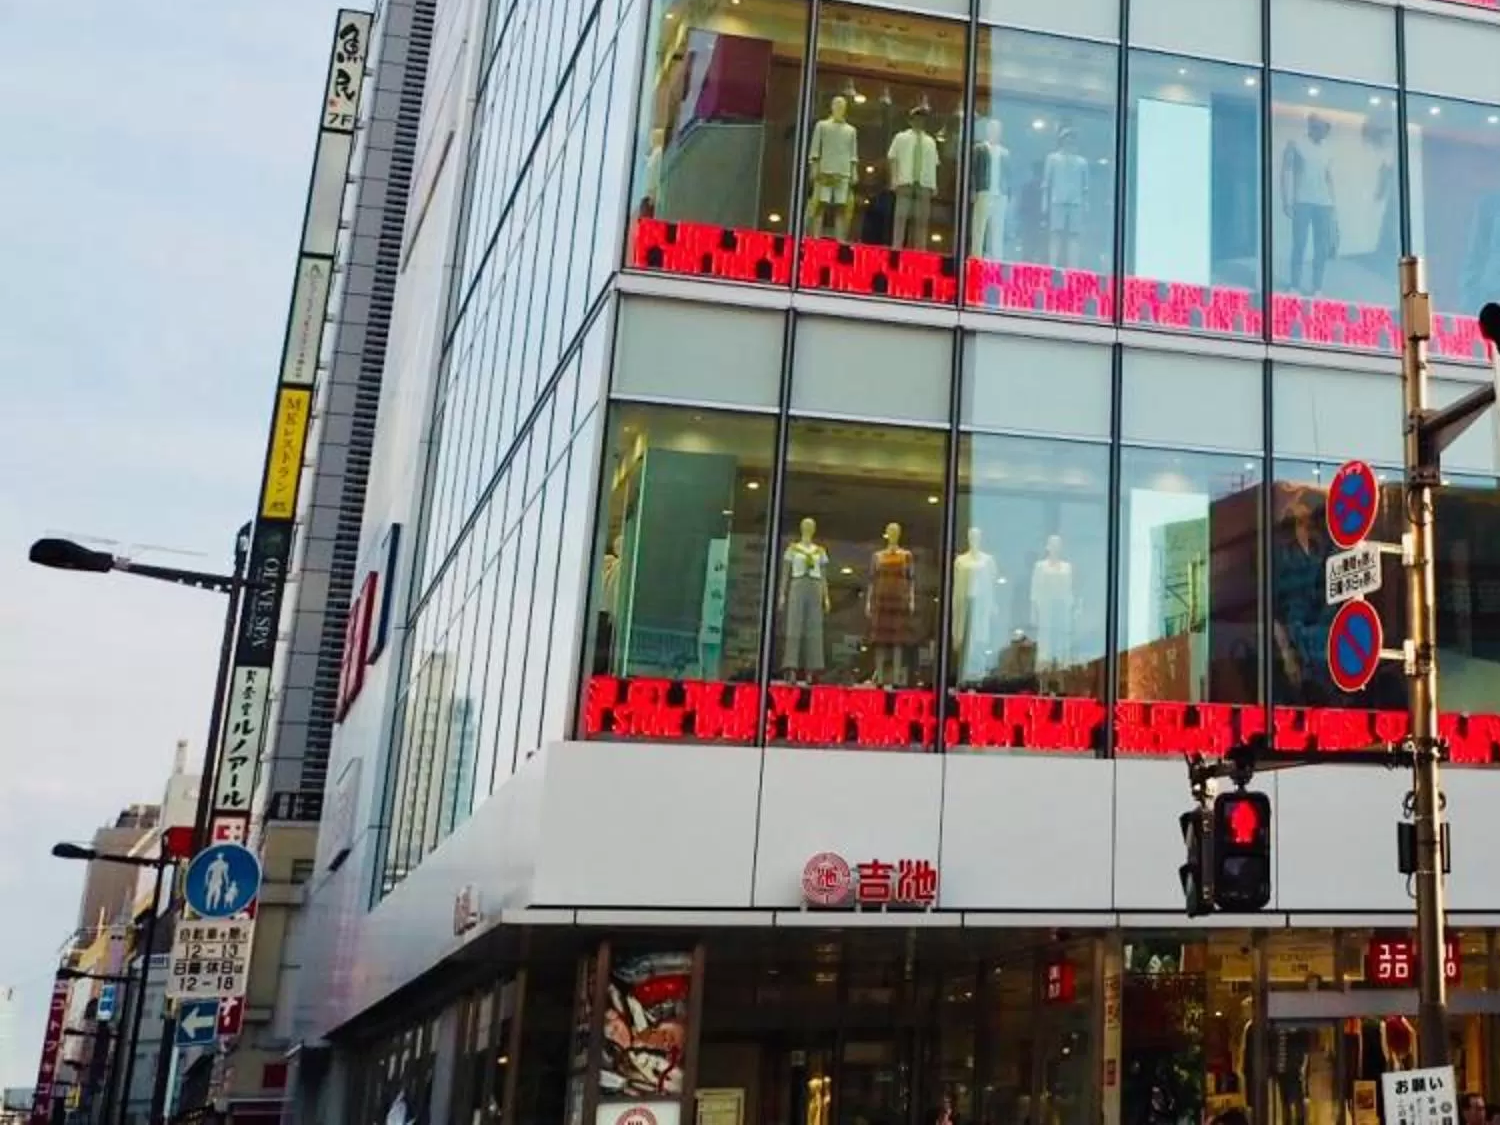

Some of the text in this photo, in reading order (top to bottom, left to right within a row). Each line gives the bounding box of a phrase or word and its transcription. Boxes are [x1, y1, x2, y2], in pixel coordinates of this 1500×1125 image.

[328, 112, 353, 127] 7F
[856, 859, 940, 906] 吉池
[1394, 1076, 1444, 1095] お願い
